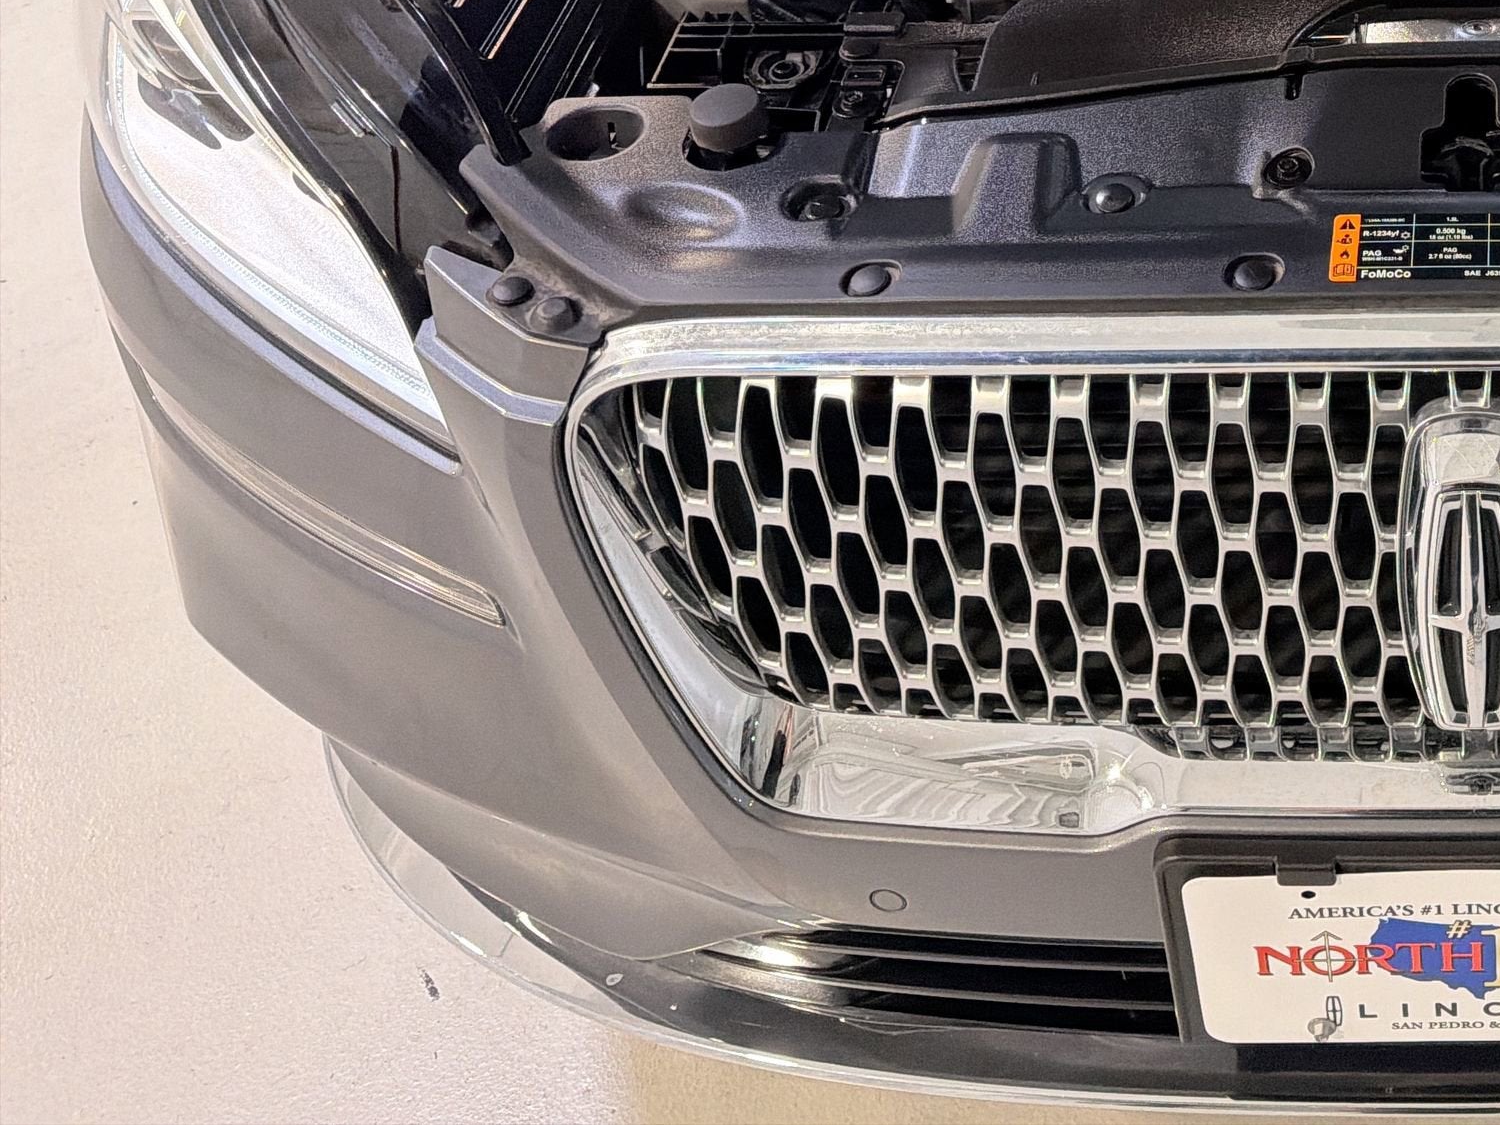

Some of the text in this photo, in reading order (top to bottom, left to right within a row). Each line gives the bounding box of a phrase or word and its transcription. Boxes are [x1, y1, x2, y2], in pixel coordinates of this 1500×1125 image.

[1362, 230, 1400, 238] R-1234yf
[1360, 269, 1412, 278] FoMoCo
[1288, 905, 1414, 919] AMERICA'S
[1420, 904, 1444, 916] #1
[1253, 941, 1485, 976] NORTH
[1391, 1021, 1423, 1030] SAN
[1428, 1021, 1485, 1029] PEDRO
